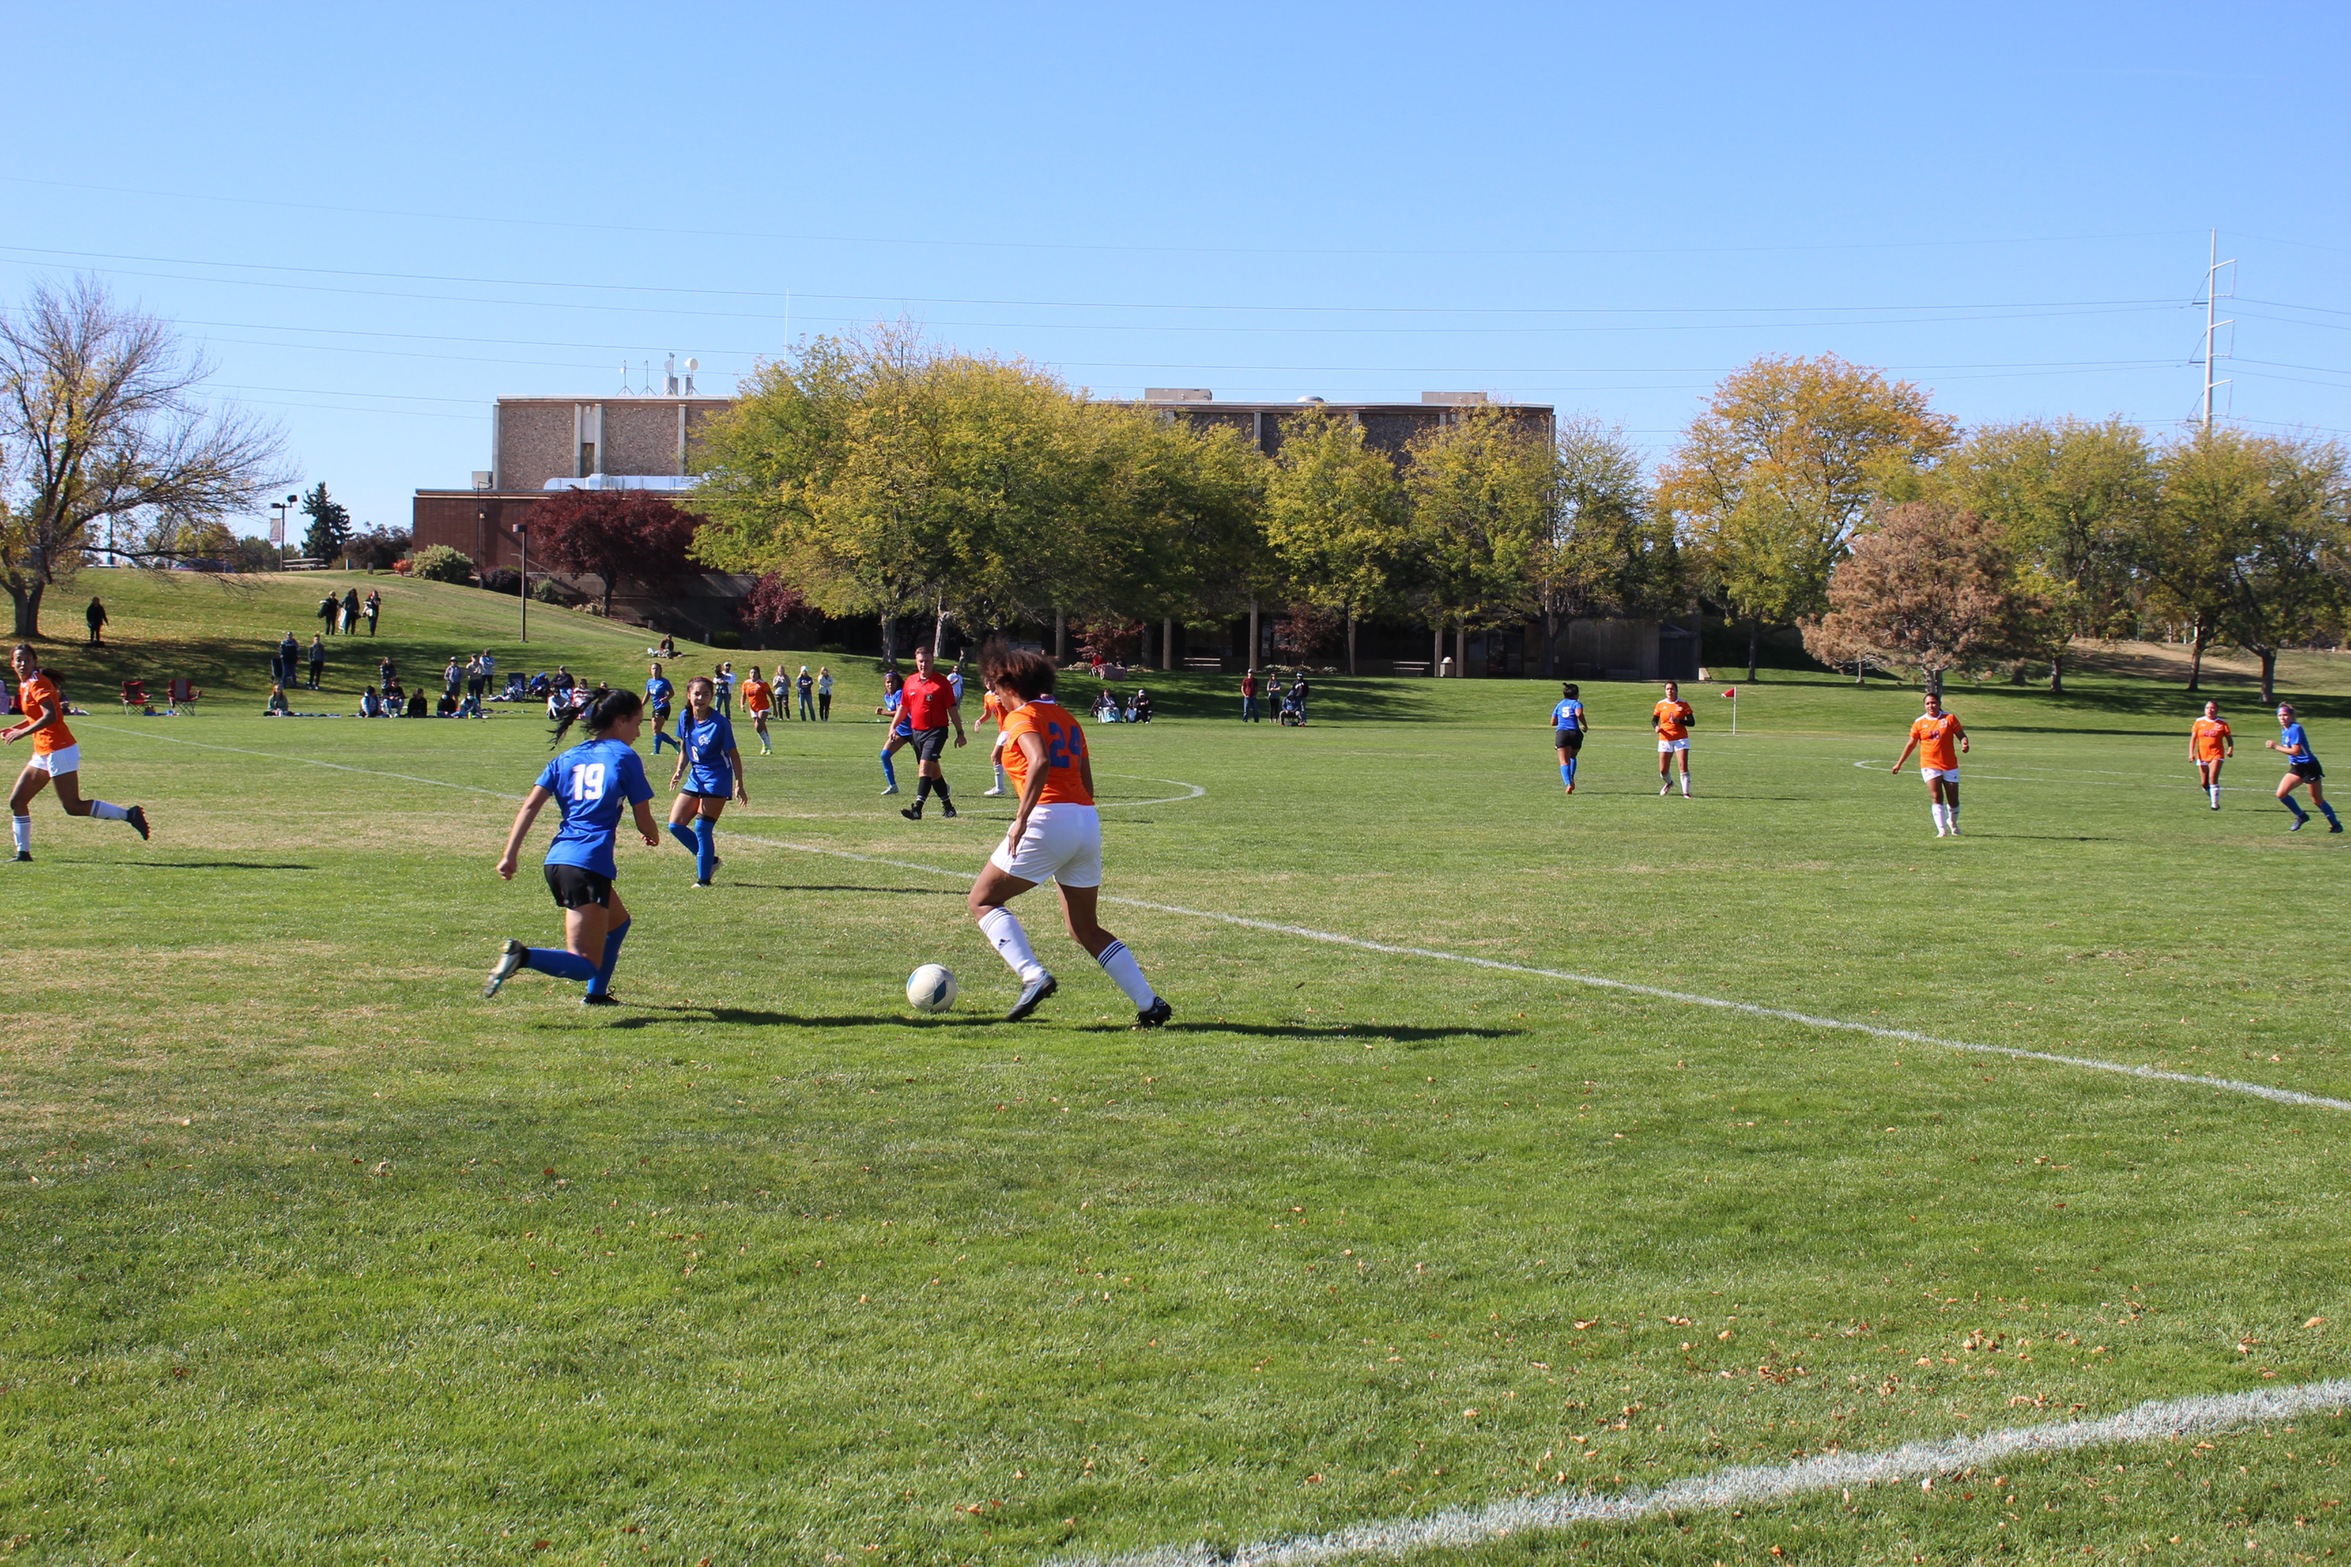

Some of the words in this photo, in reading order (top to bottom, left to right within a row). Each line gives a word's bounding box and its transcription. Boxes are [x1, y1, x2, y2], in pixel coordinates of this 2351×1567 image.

[1561, 706, 1570, 719] 5
[691, 745, 699, 762] 6
[1048, 722, 1082, 771] 24
[572, 763, 606, 801] 19
